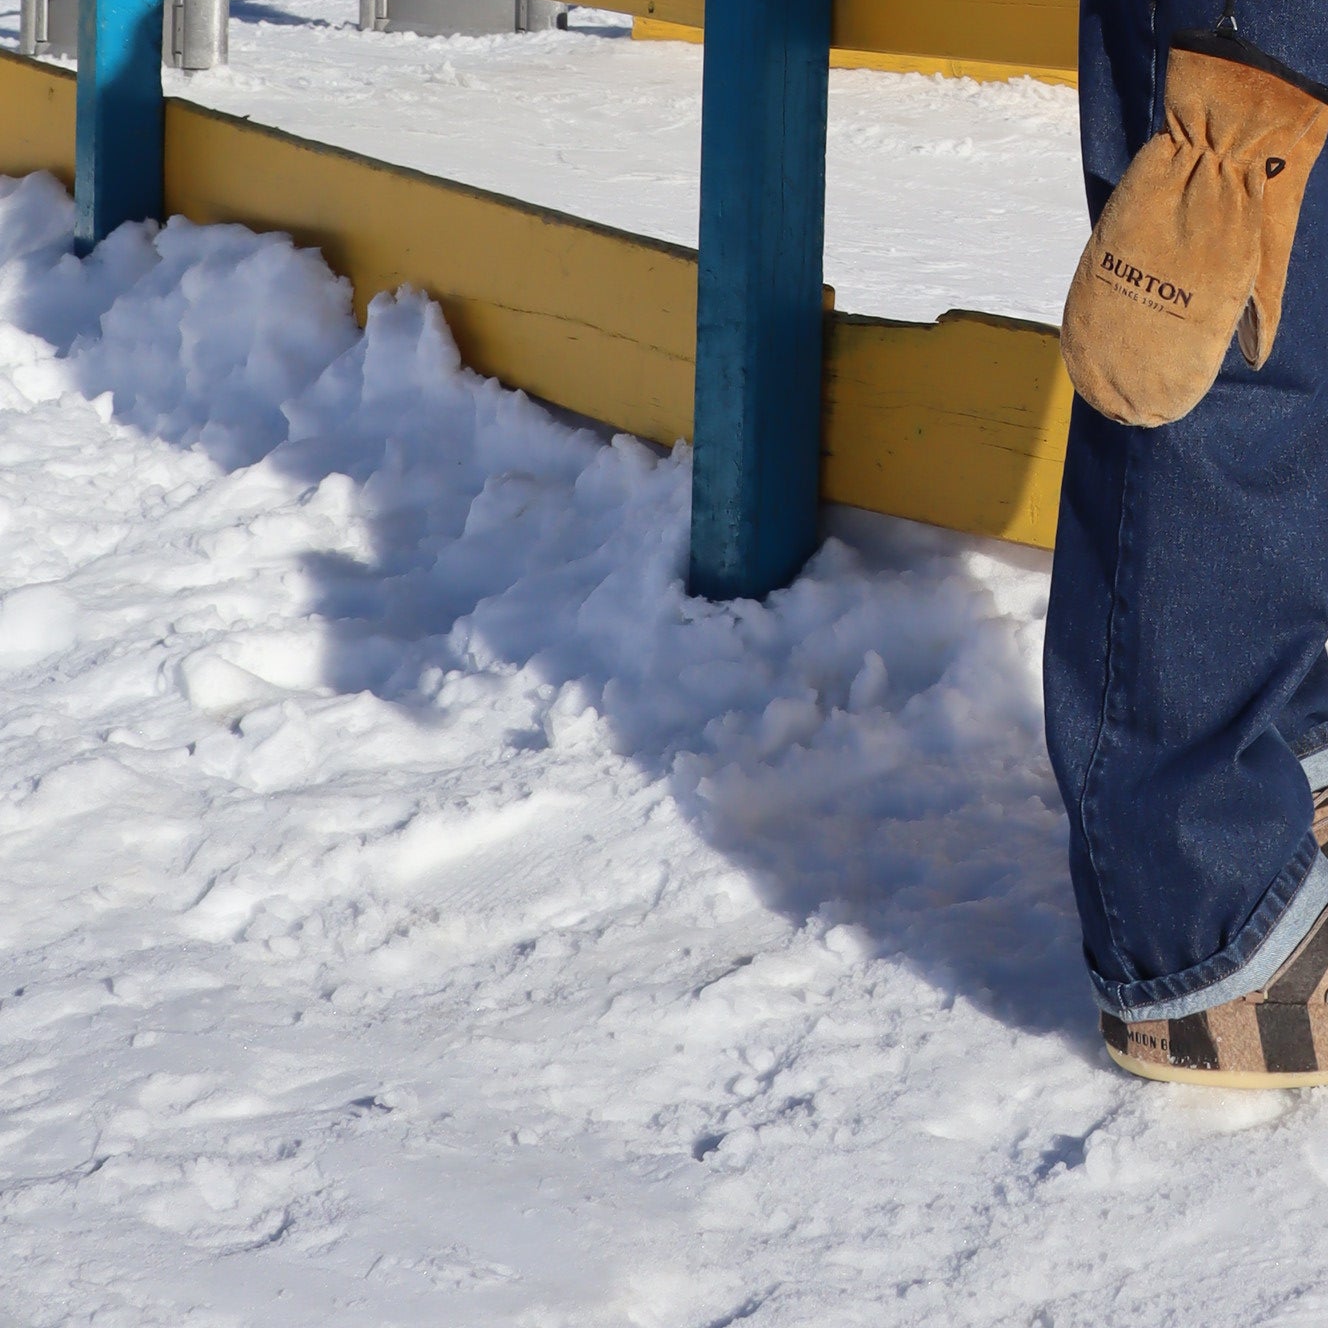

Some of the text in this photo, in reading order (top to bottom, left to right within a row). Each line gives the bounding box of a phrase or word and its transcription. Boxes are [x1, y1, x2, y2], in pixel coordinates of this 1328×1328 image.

[1100, 251, 1193, 308] BURTON
[1113, 283, 1164, 312] SINCE 1977
